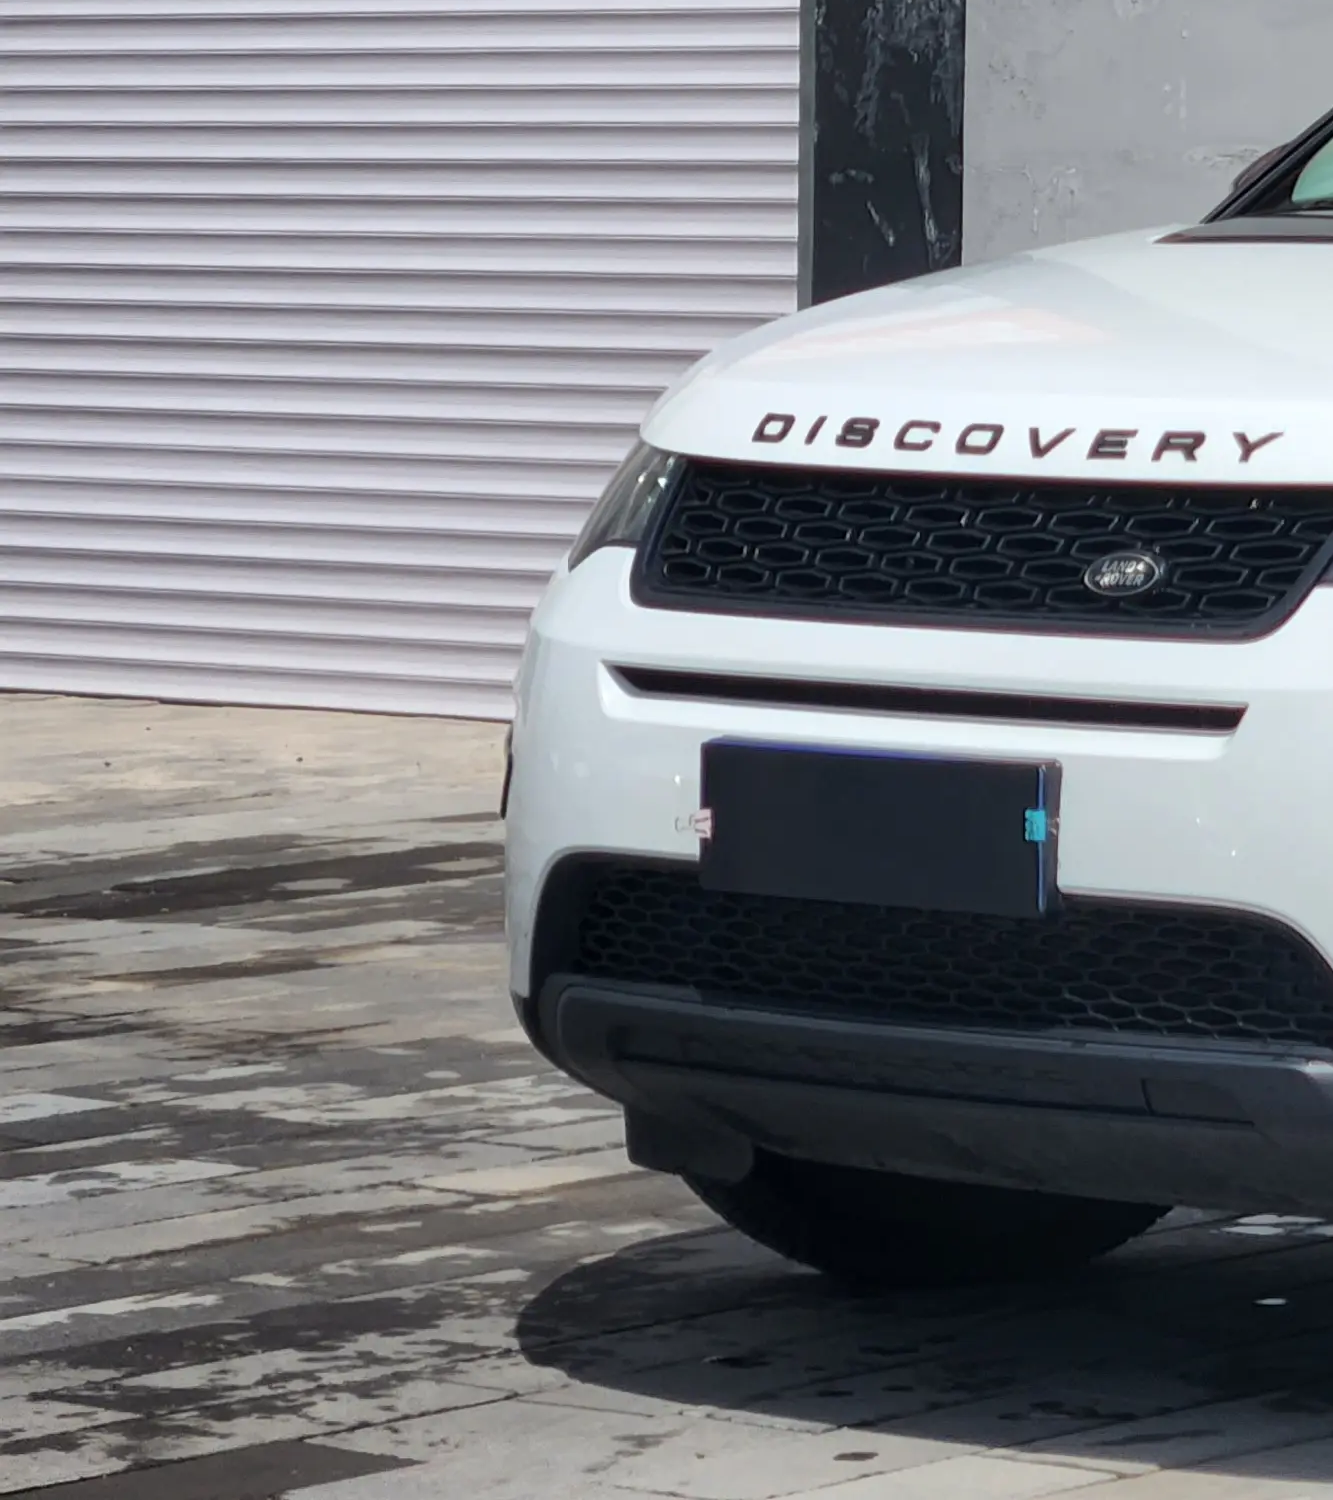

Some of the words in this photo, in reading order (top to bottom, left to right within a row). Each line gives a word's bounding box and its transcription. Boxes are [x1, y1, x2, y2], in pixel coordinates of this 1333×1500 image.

[752, 412, 1285, 464] DISCOVERY
[1101, 560, 1138, 573] LAND
[1100, 572, 1145, 589] ROVER
